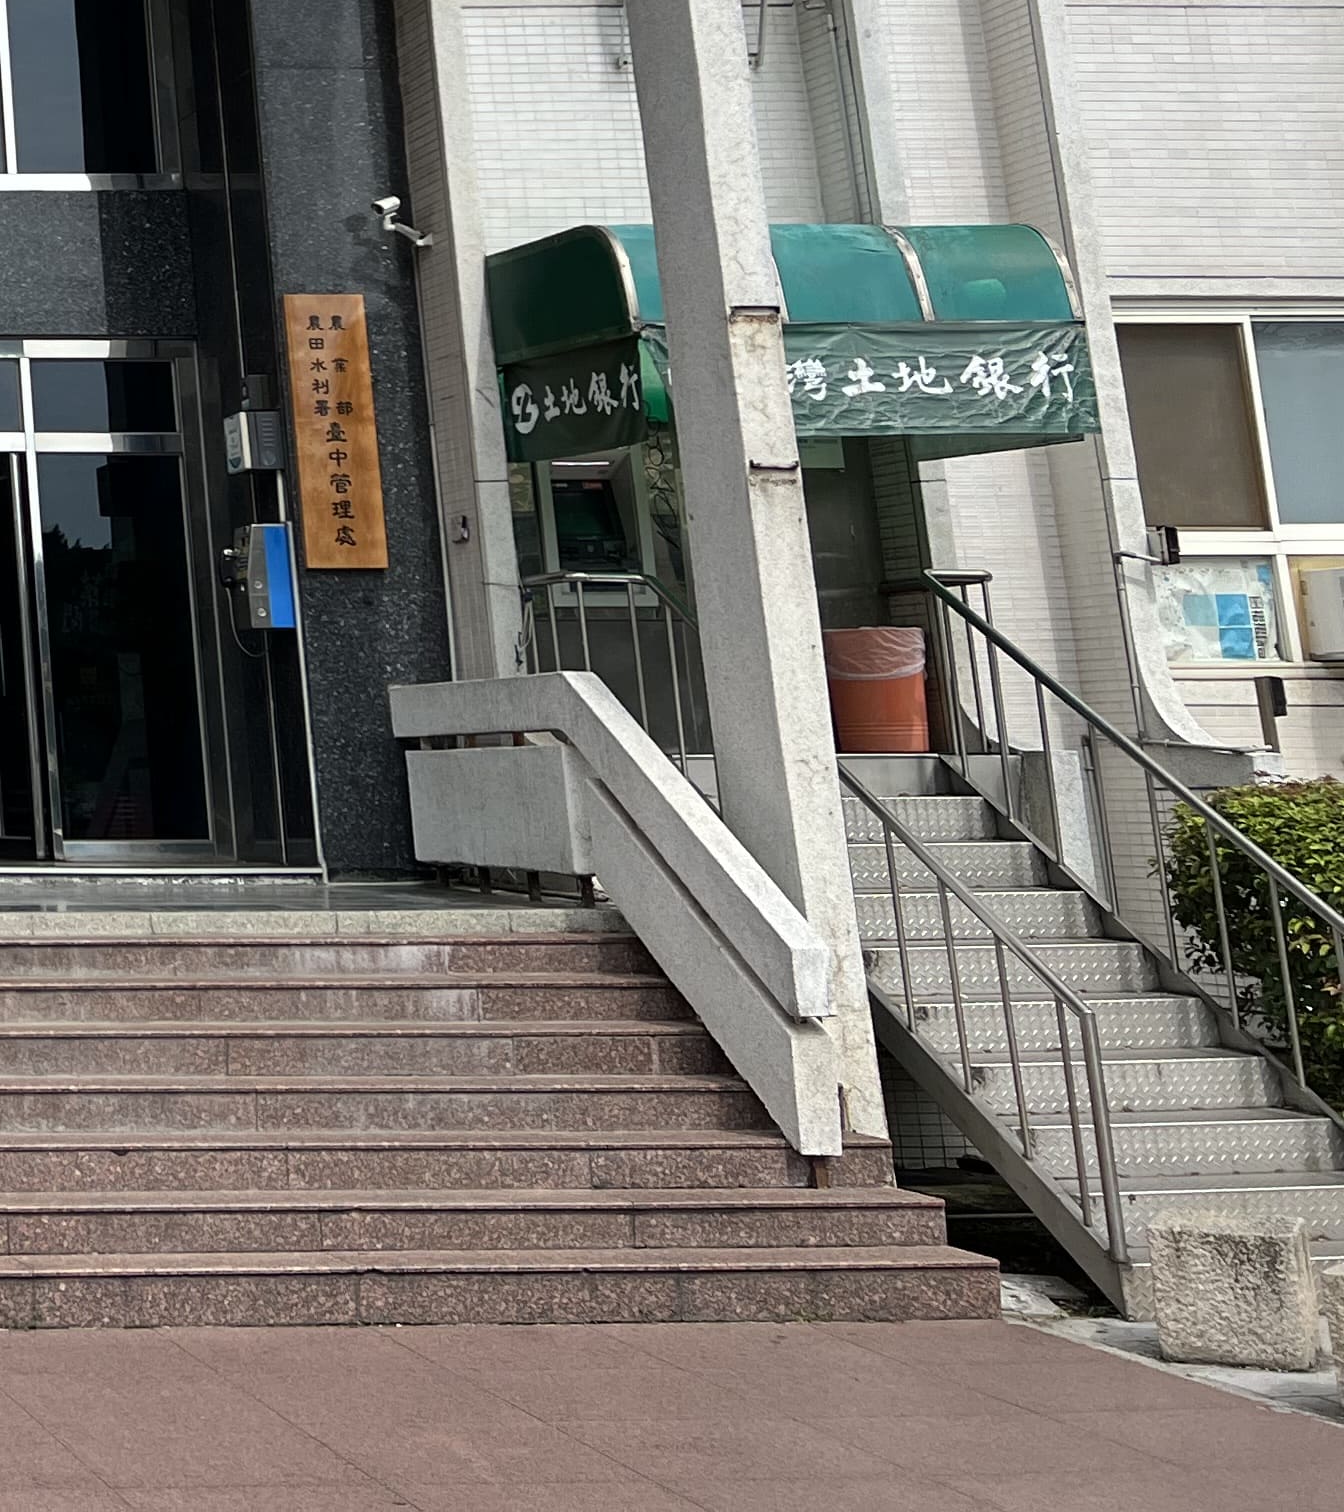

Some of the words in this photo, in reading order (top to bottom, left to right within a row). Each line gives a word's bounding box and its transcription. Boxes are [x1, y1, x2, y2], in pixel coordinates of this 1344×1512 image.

[543, 362, 640, 422] 土地銀行
[326, 421, 357, 546] 臺中管理處
